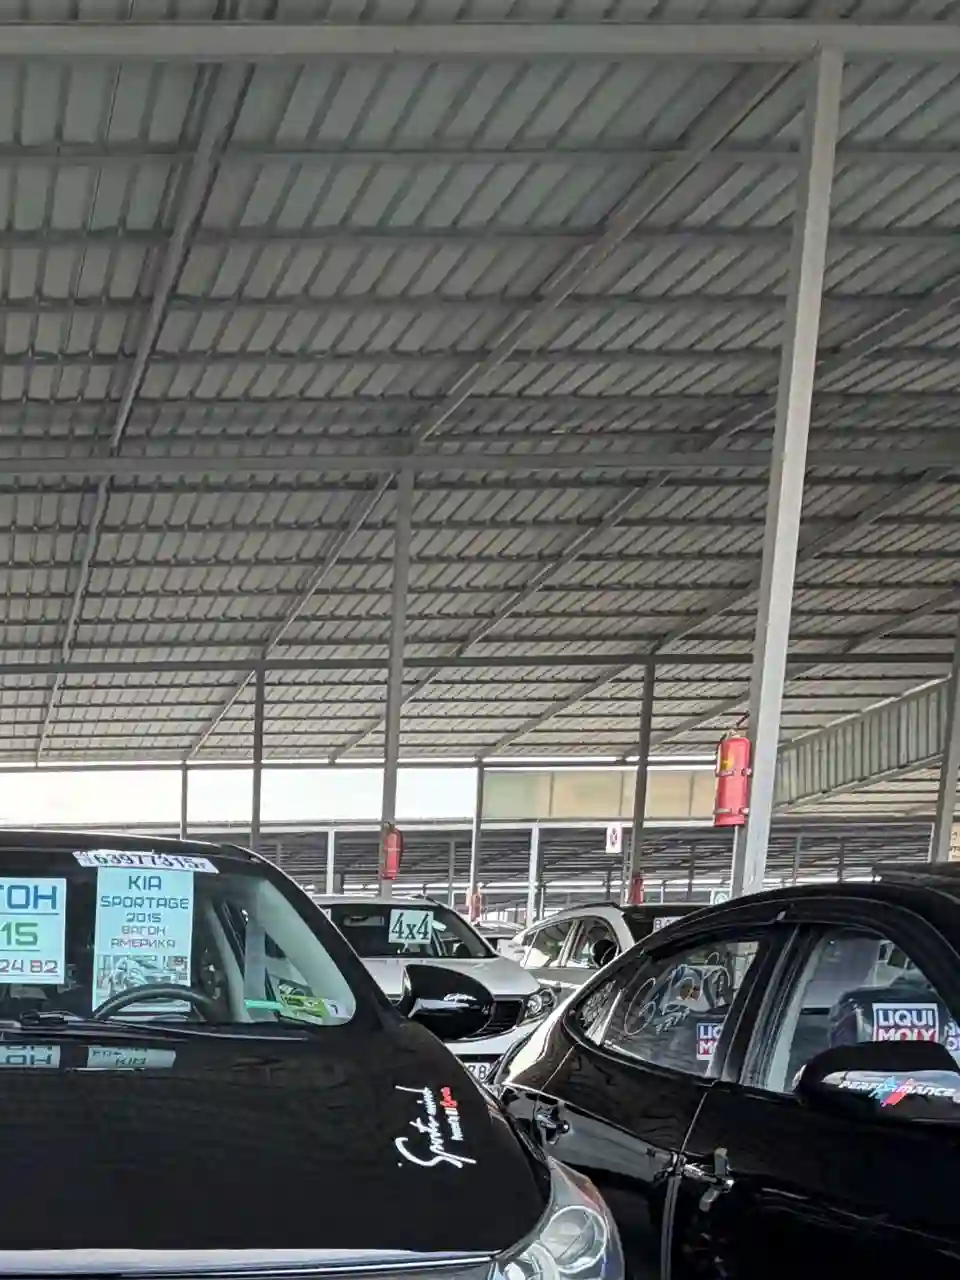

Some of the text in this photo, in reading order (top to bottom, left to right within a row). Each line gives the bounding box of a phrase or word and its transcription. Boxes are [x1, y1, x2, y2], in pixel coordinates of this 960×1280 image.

[128, 875, 162, 892] KIA
[100, 895, 189, 910] SPORTAGE
[126, 912, 162, 923] 2015
[121, 925, 166, 937] ВАГОН
[391, 912, 430, 940] 4x4
[110, 938, 176, 950] АМЕРИКА
[29, 959, 58, 974] 82
[878, 1010, 934, 1027] LIQUI
